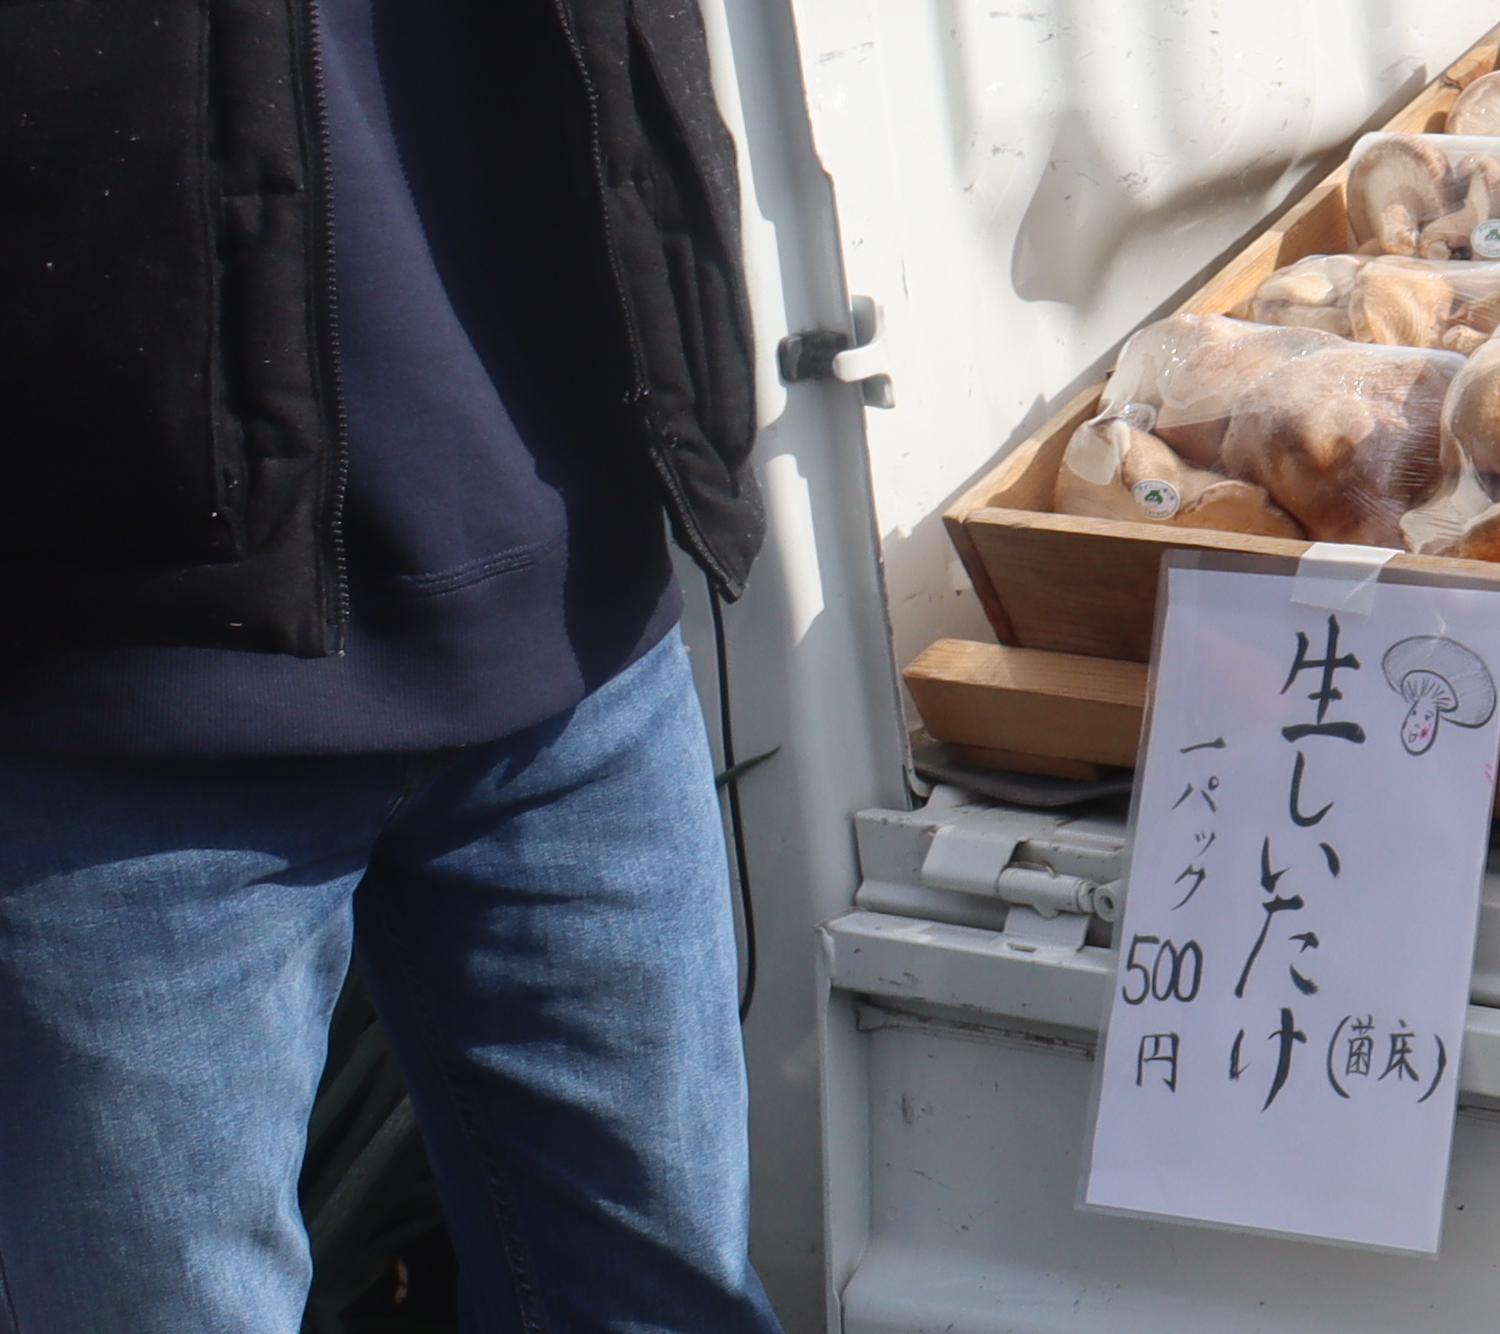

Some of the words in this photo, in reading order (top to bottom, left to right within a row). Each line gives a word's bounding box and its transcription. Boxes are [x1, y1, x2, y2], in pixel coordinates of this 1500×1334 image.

[1230, 613, 1366, 1112] 生しいたけ
